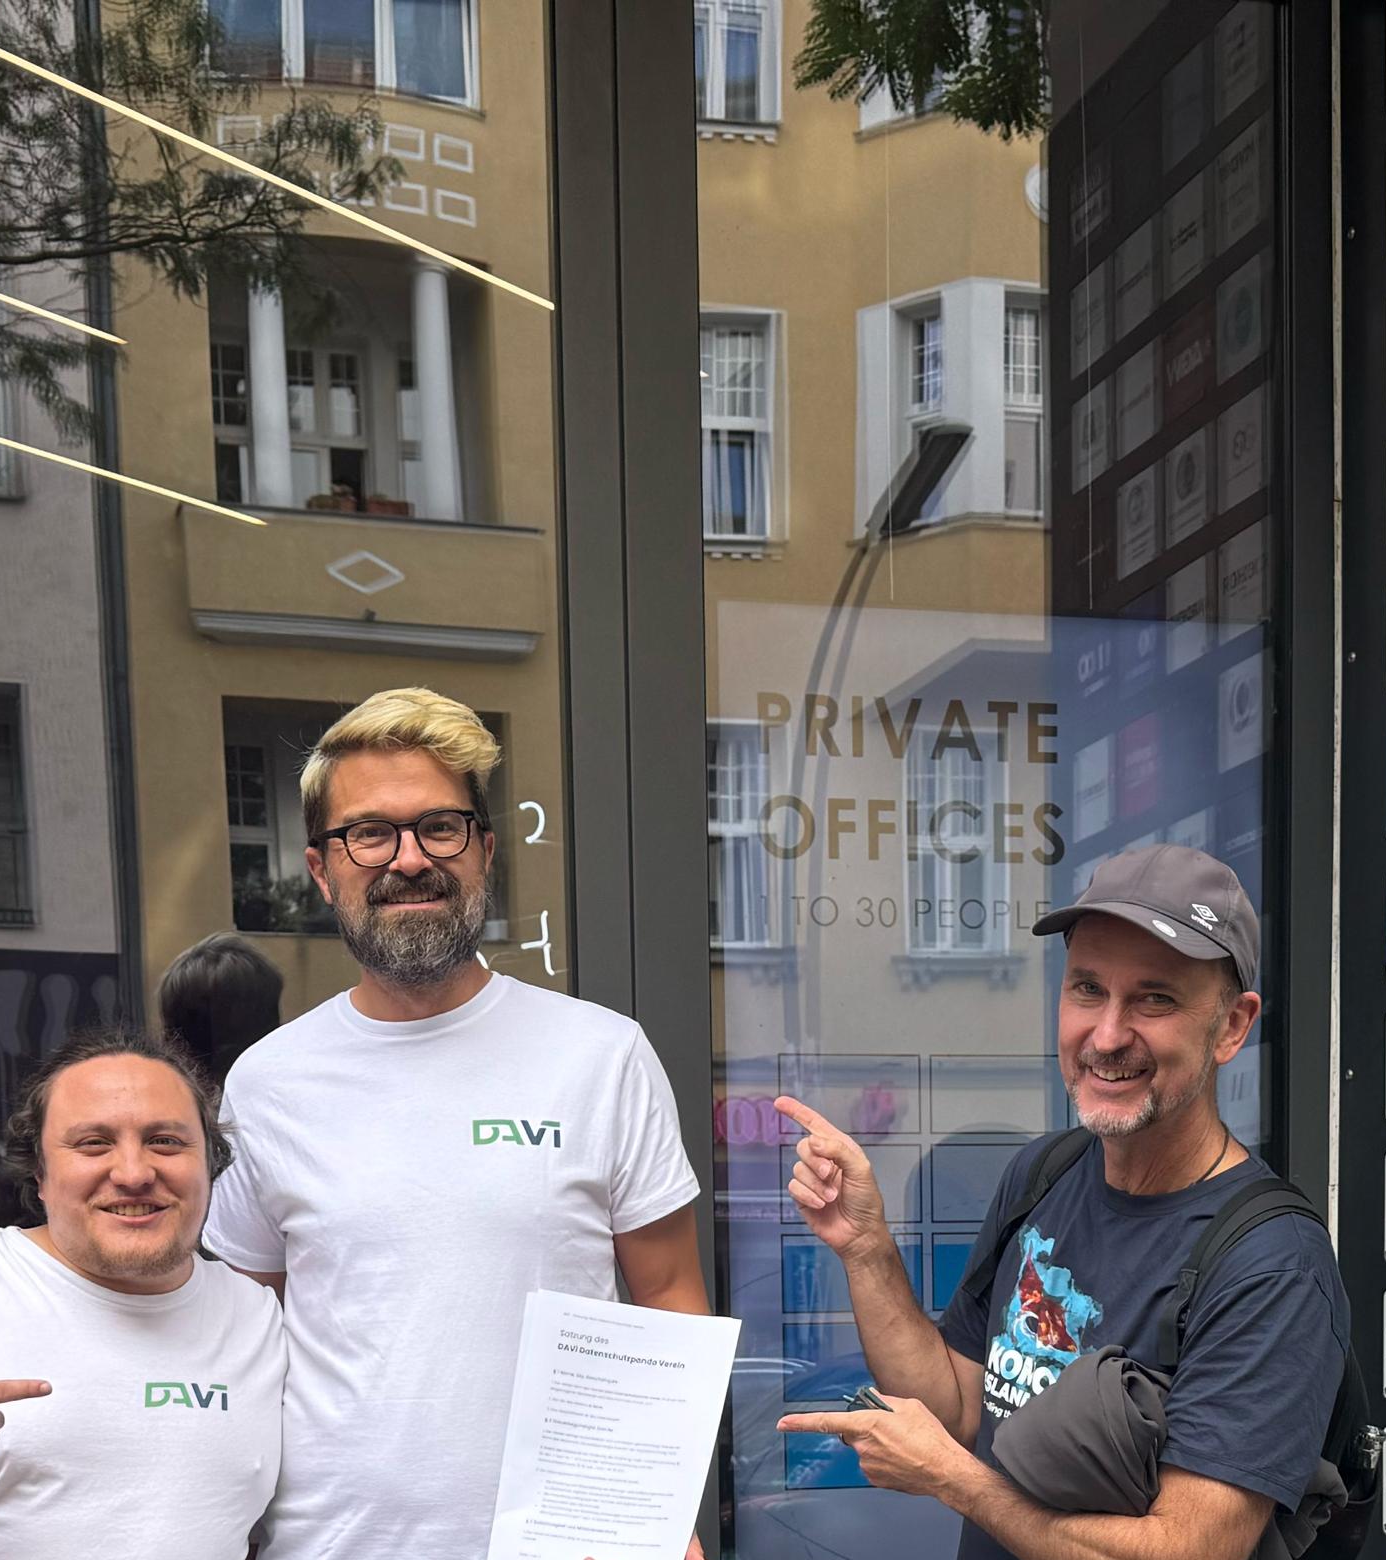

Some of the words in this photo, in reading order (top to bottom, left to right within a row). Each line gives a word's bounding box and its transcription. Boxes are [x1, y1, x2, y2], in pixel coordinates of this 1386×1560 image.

[756, 691, 1059, 764] PRIVATE
[760, 794, 1066, 867] OFFICES
[791, 895, 839, 927] TO
[855, 896, 898, 929] 30
[659, 1360, 685, 1369] Verein
